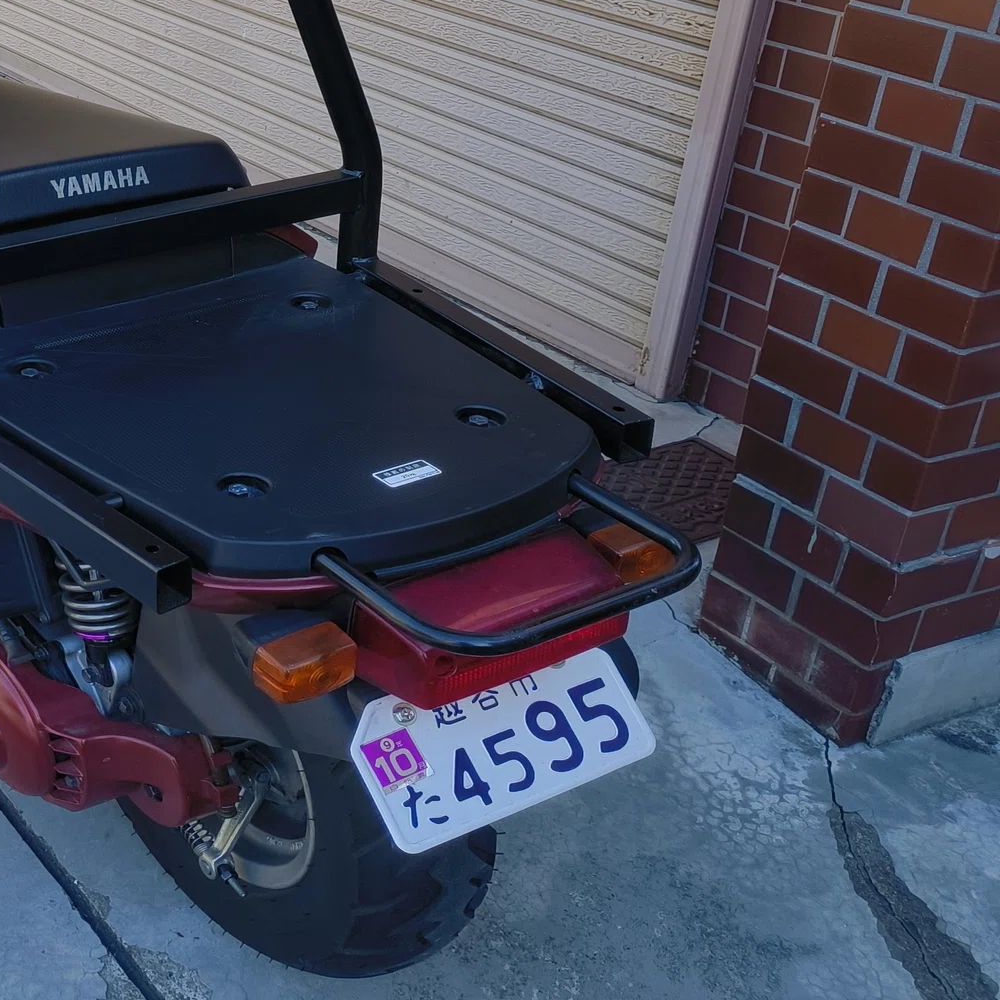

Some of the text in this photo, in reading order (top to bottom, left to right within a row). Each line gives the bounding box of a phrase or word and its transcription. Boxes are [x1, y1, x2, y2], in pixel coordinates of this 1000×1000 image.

[50, 166, 149, 198] YAMAHA
[375, 748, 417, 783] 10
[403, 677, 630, 828] た 4595
